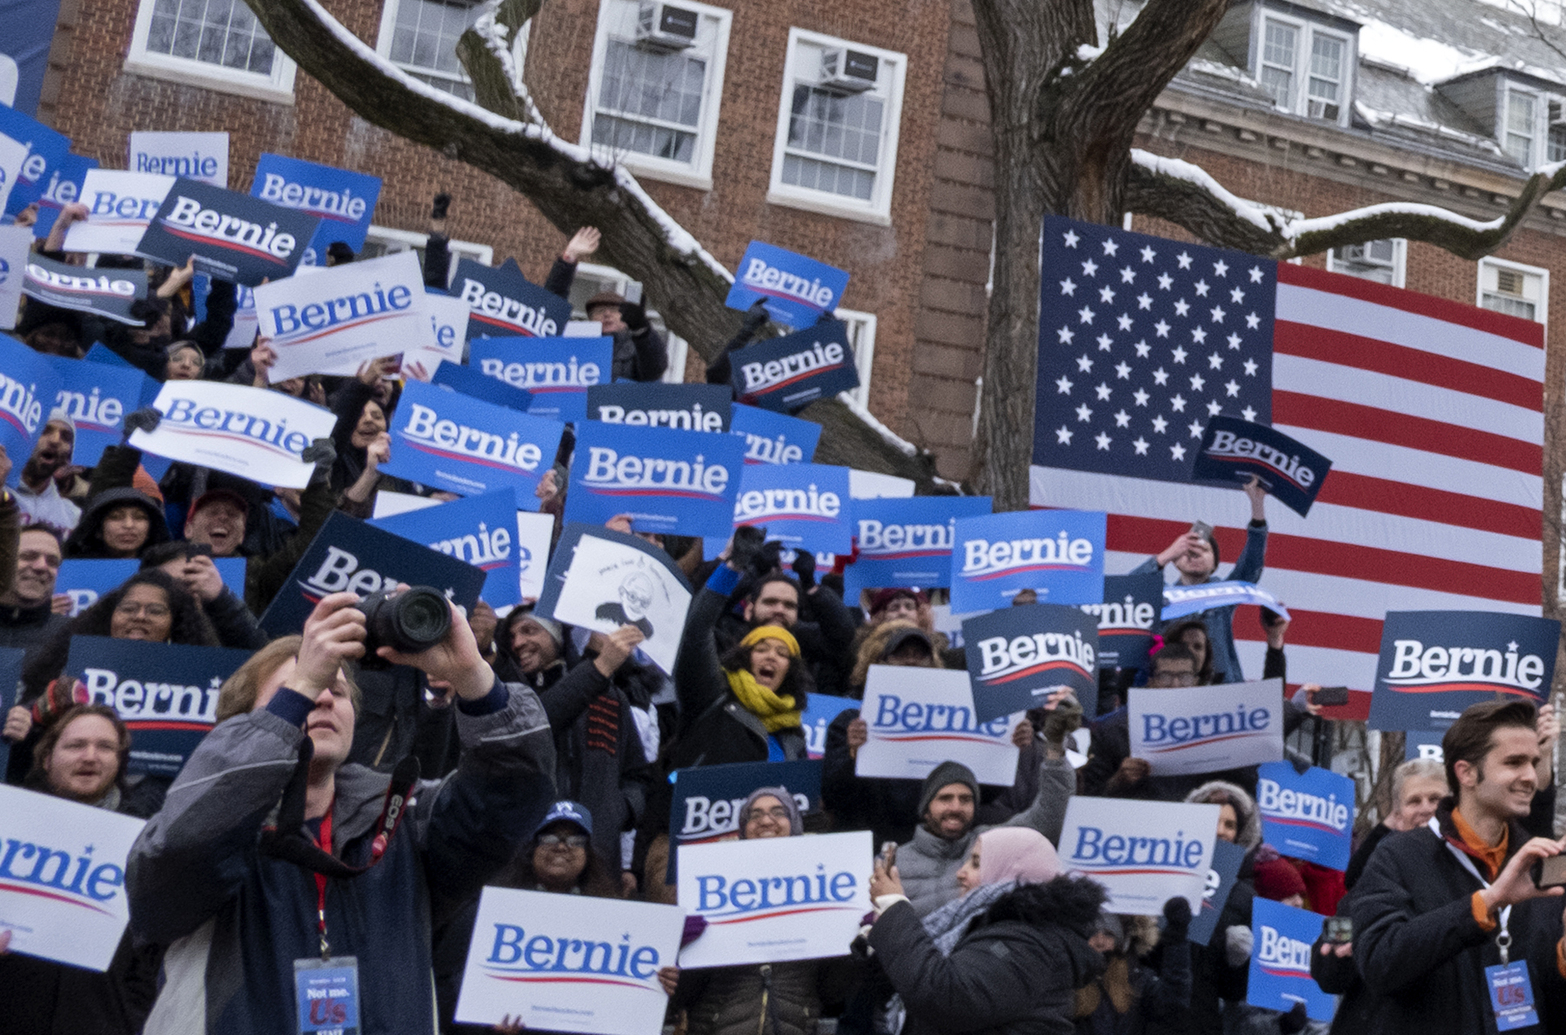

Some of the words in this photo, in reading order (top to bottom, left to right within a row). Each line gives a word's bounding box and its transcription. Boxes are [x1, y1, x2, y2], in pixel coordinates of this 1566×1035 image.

[137, 151, 218, 177] Bernie
[92, 191, 161, 219] Ber
[260, 172, 366, 221] Bernie
[166, 195, 296, 258] Bernie
[25, 264, 135, 296] ernie
[743, 258, 834, 308] Bernie
[270, 281, 412, 336] Bernie
[461, 278, 557, 337] Bernie
[741, 341, 845, 389] Bernie
[163, 398, 311, 453] Bernie
[403, 403, 542, 471] Bernie
[584, 446, 729, 495] Bernie
[1207, 430, 1316, 488] Bernie
[735, 484, 840, 517] ernie
[857, 517, 955, 550] Berni
[962, 530, 1093, 572] Bernie
[978, 631, 1095, 675] Bernie
[1388, 640, 1545, 689] Bernie
[84, 668, 221, 722] Berni
[873, 694, 1010, 738] Berne
[1142, 703, 1271, 743] Bernie
[1258, 778, 1349, 830] Bernie
[0, 837, 123, 902] rnie
[1071, 826, 1203, 869] Bernie
[694, 863, 857, 912] Bernie
[486, 923, 659, 979] Bernie
[1259, 925, 1311, 971] Bern
[309, 998, 347, 1025] Us
